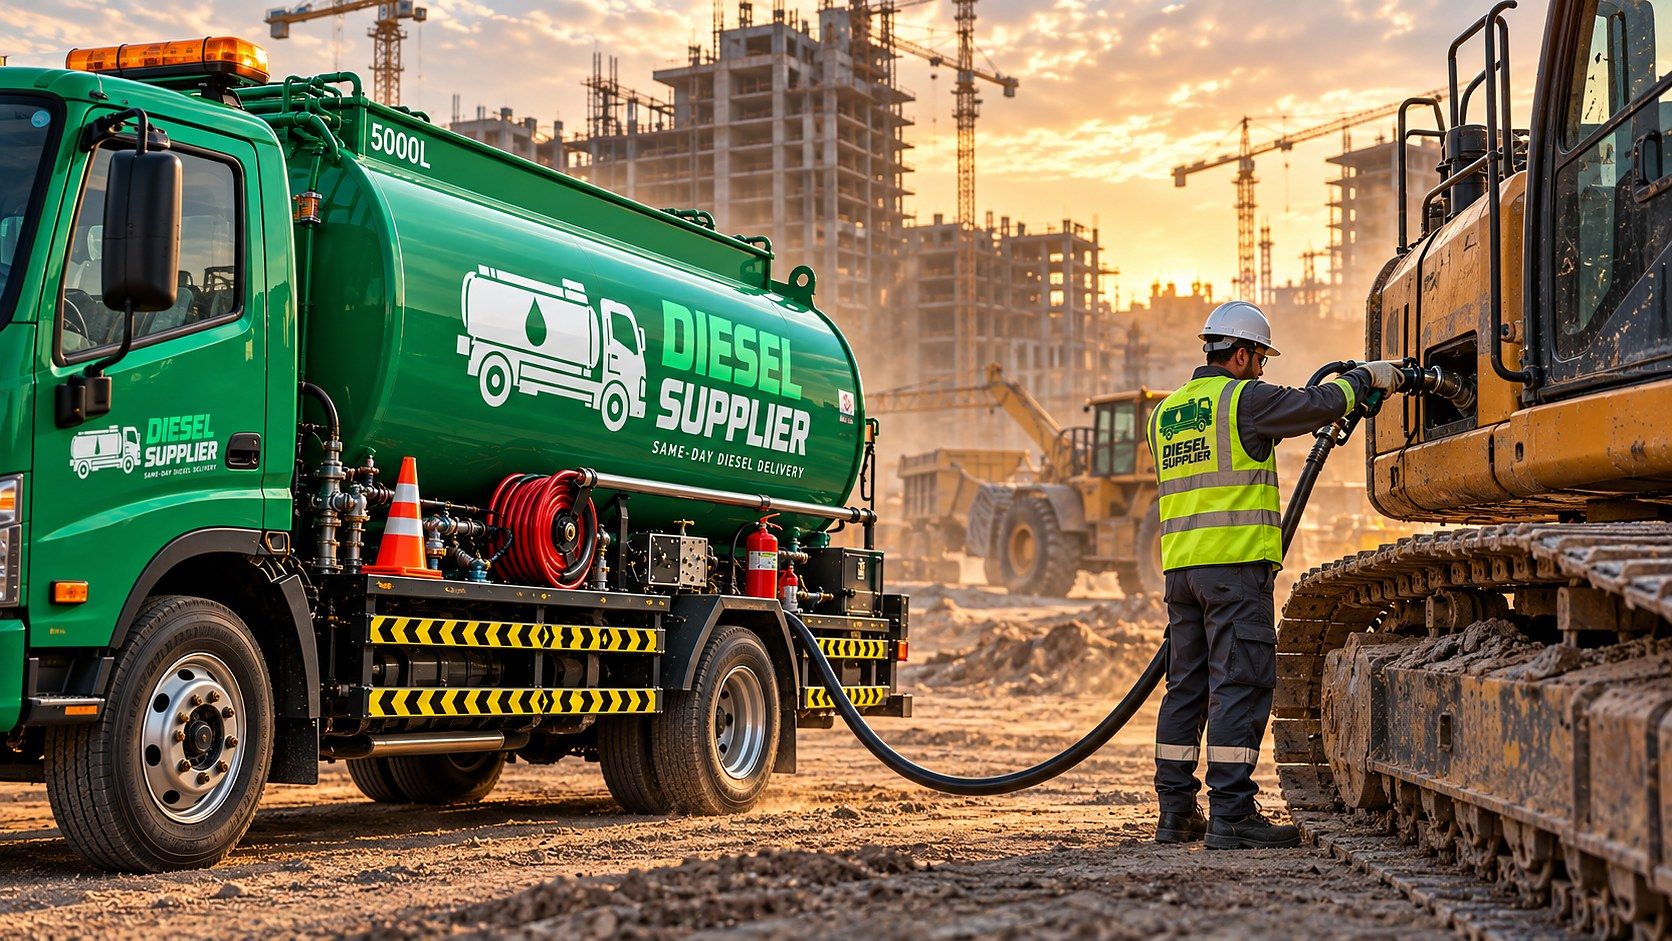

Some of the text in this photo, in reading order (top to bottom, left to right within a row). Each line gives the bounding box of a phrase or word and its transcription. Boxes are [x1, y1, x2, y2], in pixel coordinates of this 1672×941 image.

[370, 122, 431, 169] 5000L
[661, 299, 803, 400] DIESEL
[146, 413, 214, 444] DIESEL
[655, 377, 811, 456] SUPPLIER
[144, 440, 218, 468] SUPPLIER
[651, 440, 805, 479] SAME-DAY DIESEL DELIVERY
[1162, 449, 1211, 470] SUPPLIER
[1163, 437, 1210, 459] DIESEL
